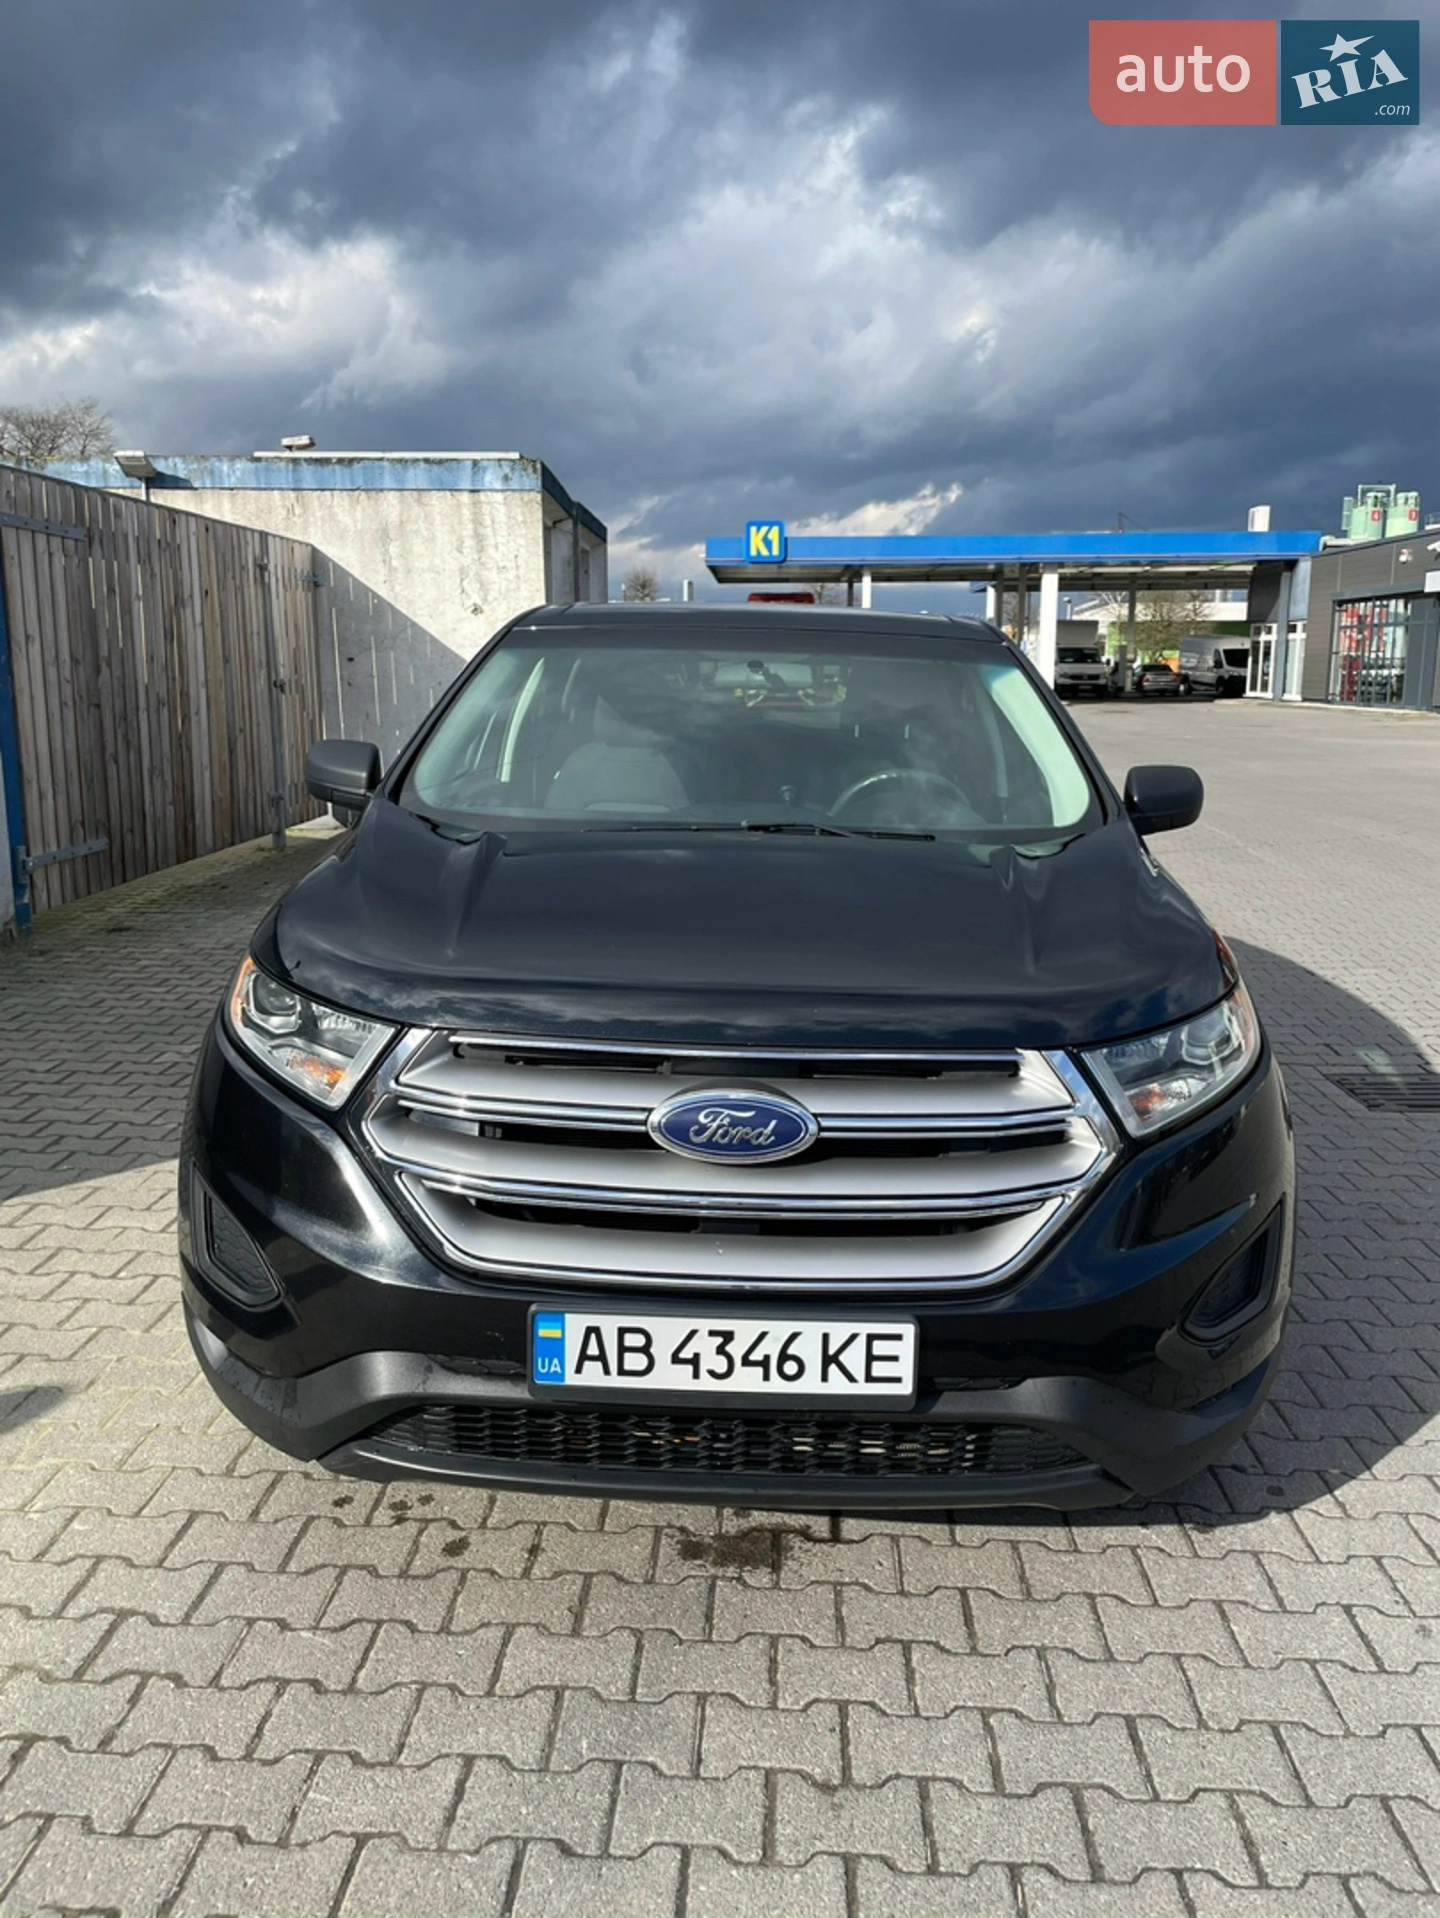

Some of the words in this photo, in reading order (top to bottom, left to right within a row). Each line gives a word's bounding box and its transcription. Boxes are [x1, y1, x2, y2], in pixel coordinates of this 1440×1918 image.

[750, 526, 779, 556] K1
[689, 1107, 777, 1145] Ford
[538, 1358, 562, 1374] UA
[574, 1326, 655, 1377] AB
[670, 1329, 806, 1382] 4346
[821, 1332, 903, 1383] KE
